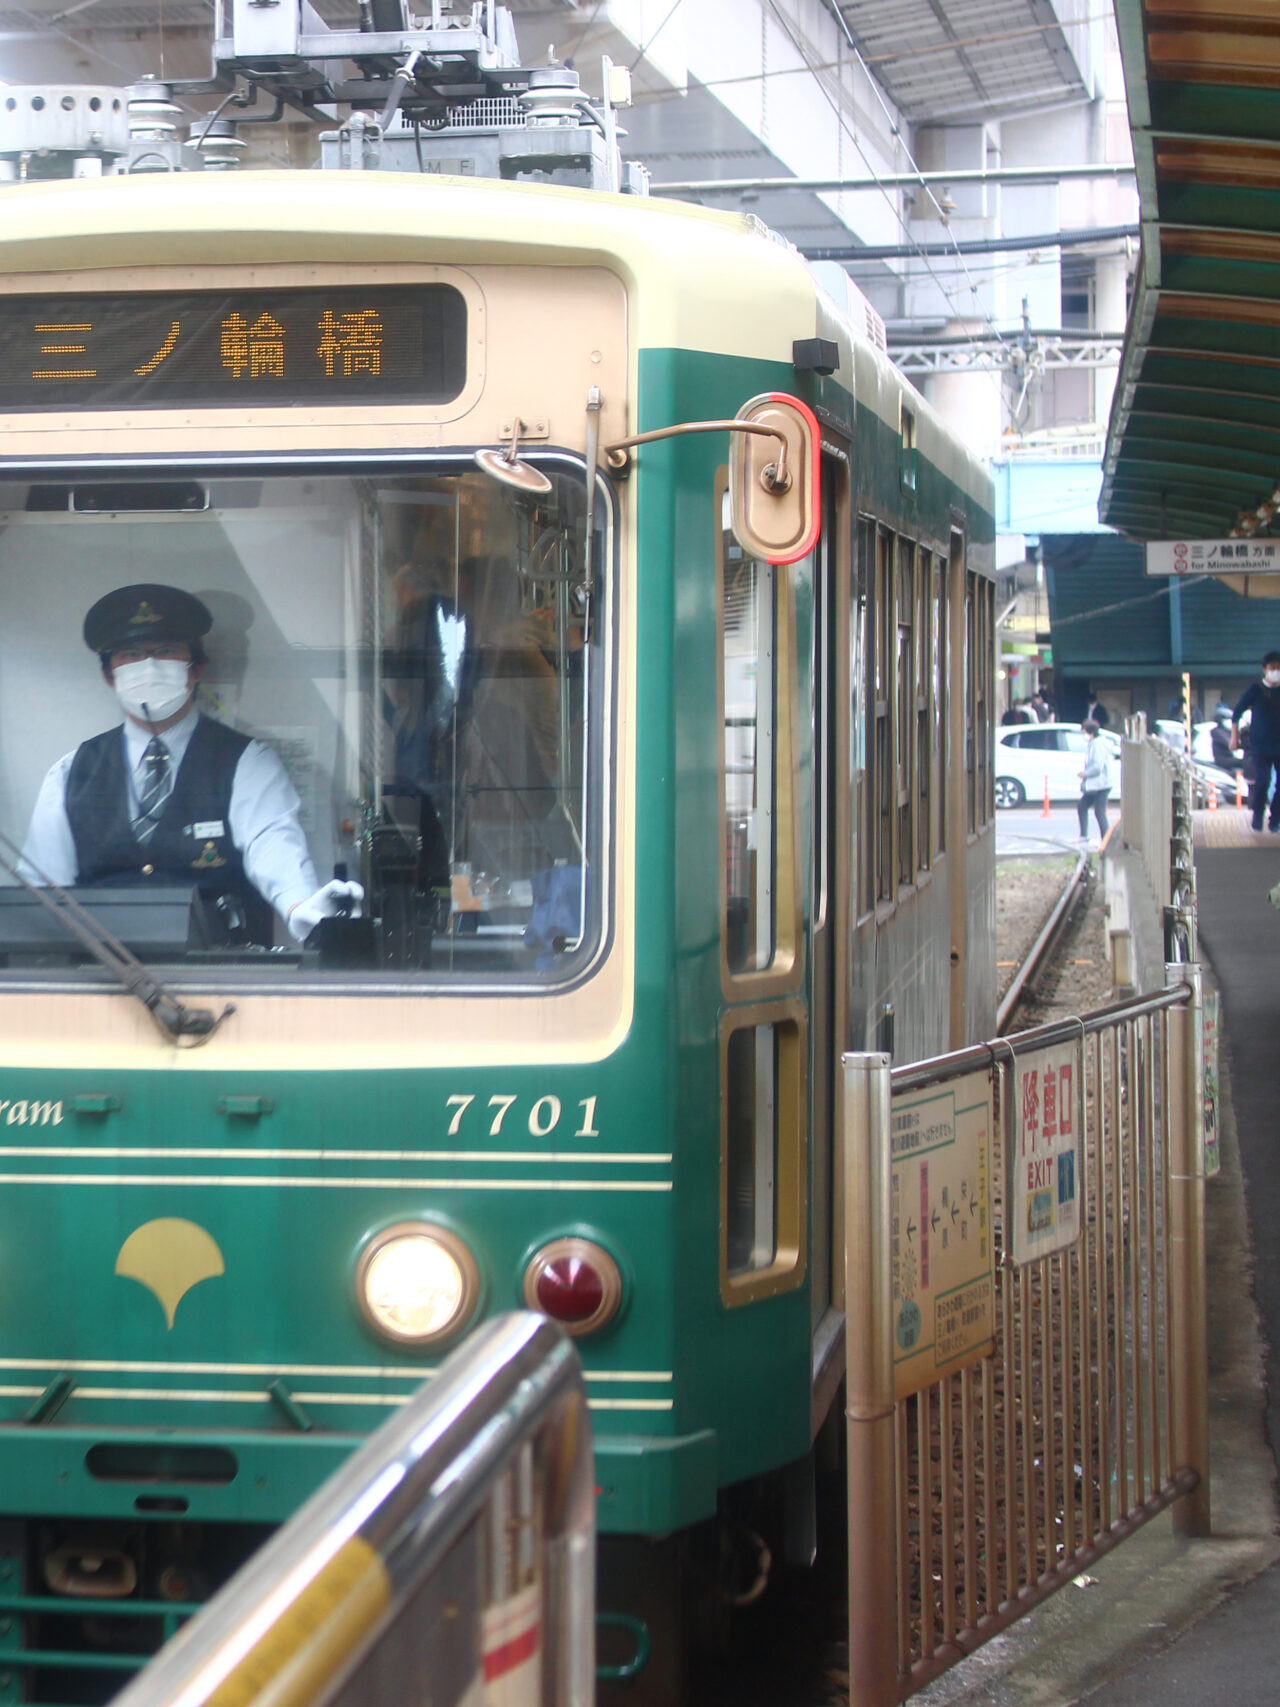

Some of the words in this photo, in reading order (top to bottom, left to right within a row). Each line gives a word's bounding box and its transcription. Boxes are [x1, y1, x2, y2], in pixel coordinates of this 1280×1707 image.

[32, 310, 383, 378] 三ノ輪橋
[446, 1095, 599, 1137] 7701
[1022, 1064, 1072, 1156] 降車口
[1028, 1158, 1053, 1190] EXIT
